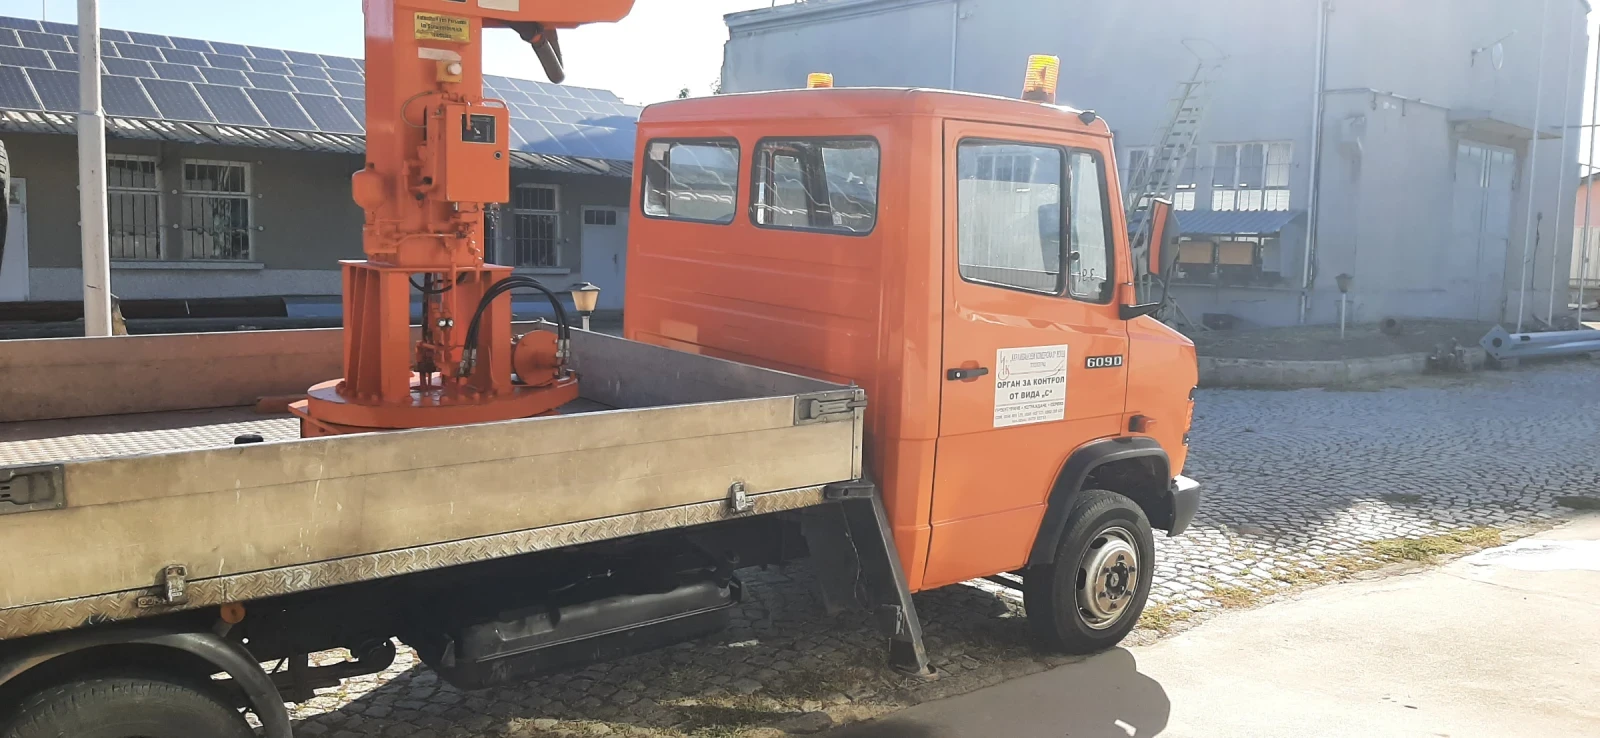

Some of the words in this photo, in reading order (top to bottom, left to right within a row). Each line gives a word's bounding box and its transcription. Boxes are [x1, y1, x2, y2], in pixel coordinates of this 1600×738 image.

[997, 379, 1021, 389] ОРГАН
[1022, 379, 1032, 387] ЗА
[1033, 376, 1065, 386] КОНТРОЛ
[1009, 392, 1019, 400] ОТ
[1021, 390, 1040, 400] ВИДА
